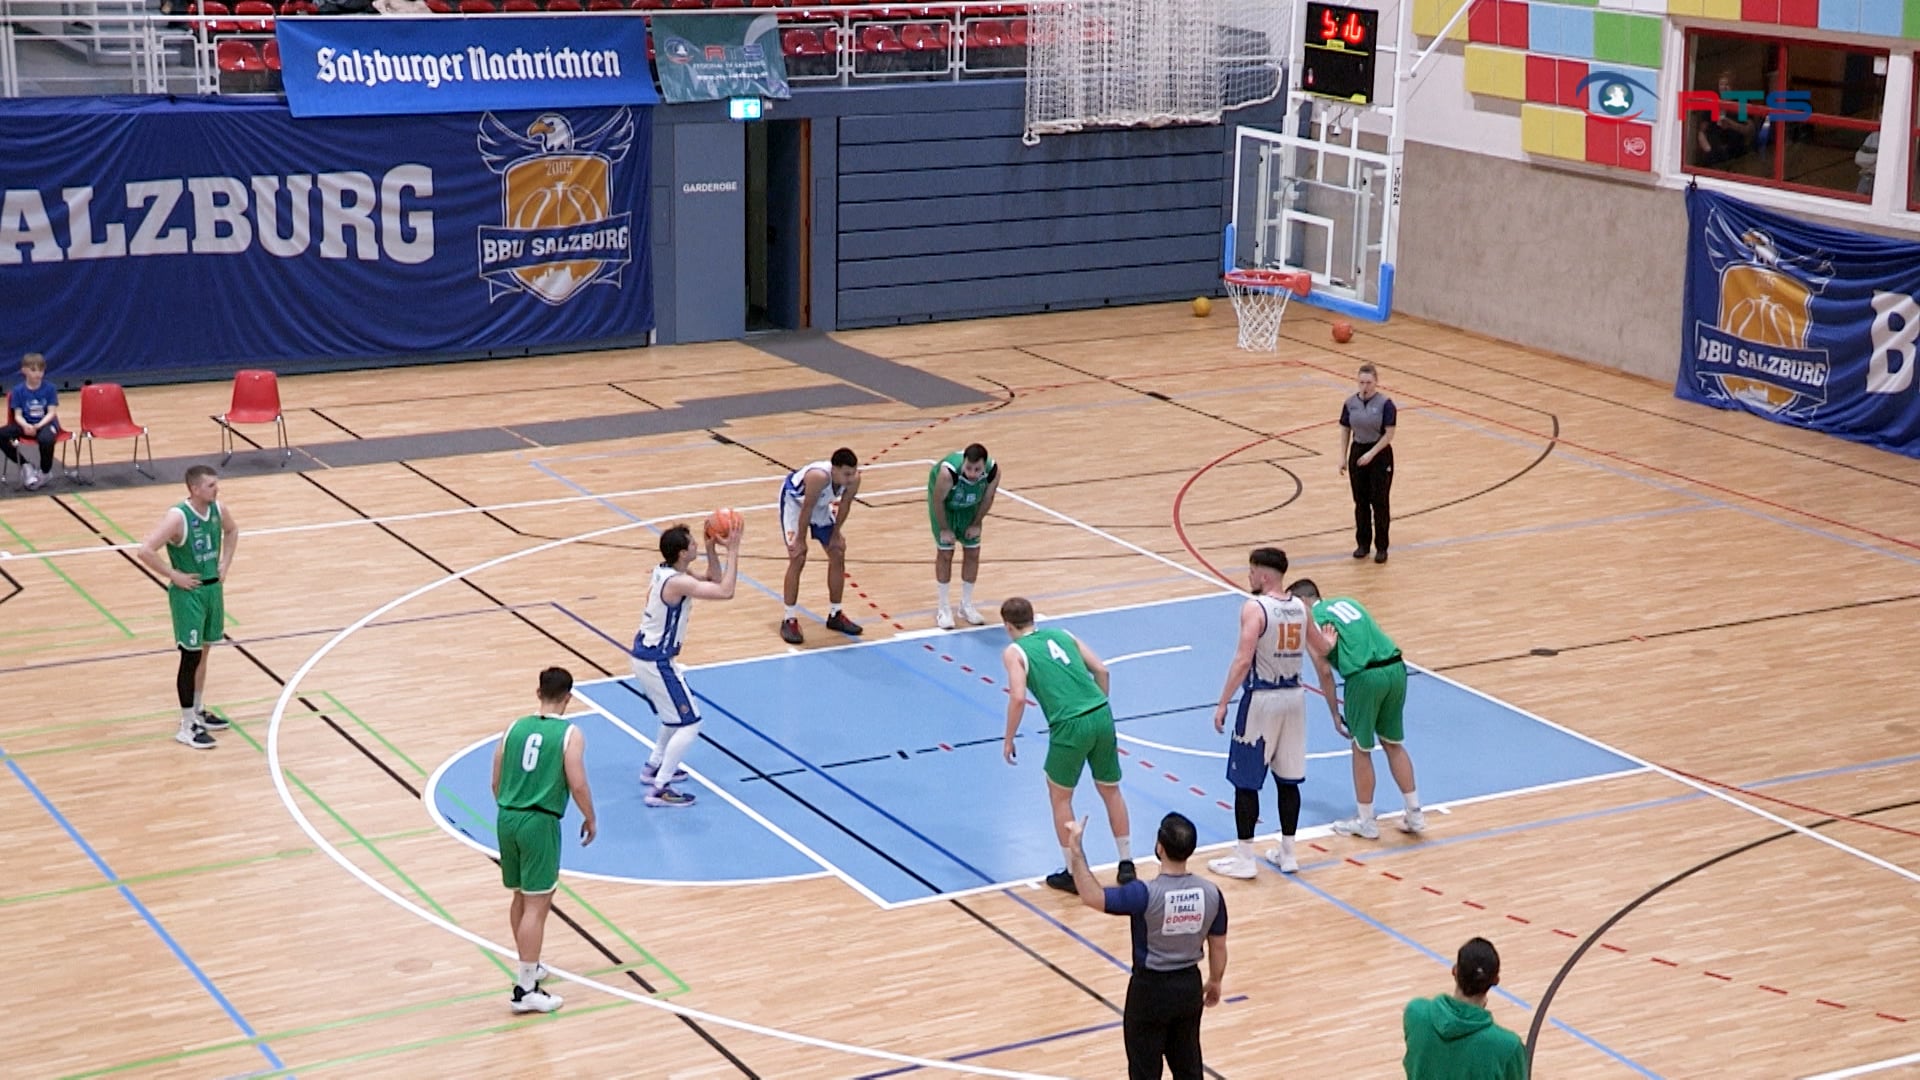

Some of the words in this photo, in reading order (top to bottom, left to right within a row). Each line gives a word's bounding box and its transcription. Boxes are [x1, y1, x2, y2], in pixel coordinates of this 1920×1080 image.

[315, 46, 464, 88] Salzburger
[467, 45, 621, 81] Nachrichten
[544, 160, 574, 177] 2005
[683, 181, 737, 194] GARDEROBE
[0, 163, 434, 265] ALZBURG
[482, 238, 525, 265] BBU
[531, 225, 629, 257] SALZBURG
[1736, 348, 1827, 387] SALZBURG
[1326, 601, 1362, 624] 10
[188, 628, 199, 647] 3
[1277, 622, 1303, 651] 15
[1046, 638, 1071, 665] 4
[521, 732, 543, 773] 6
